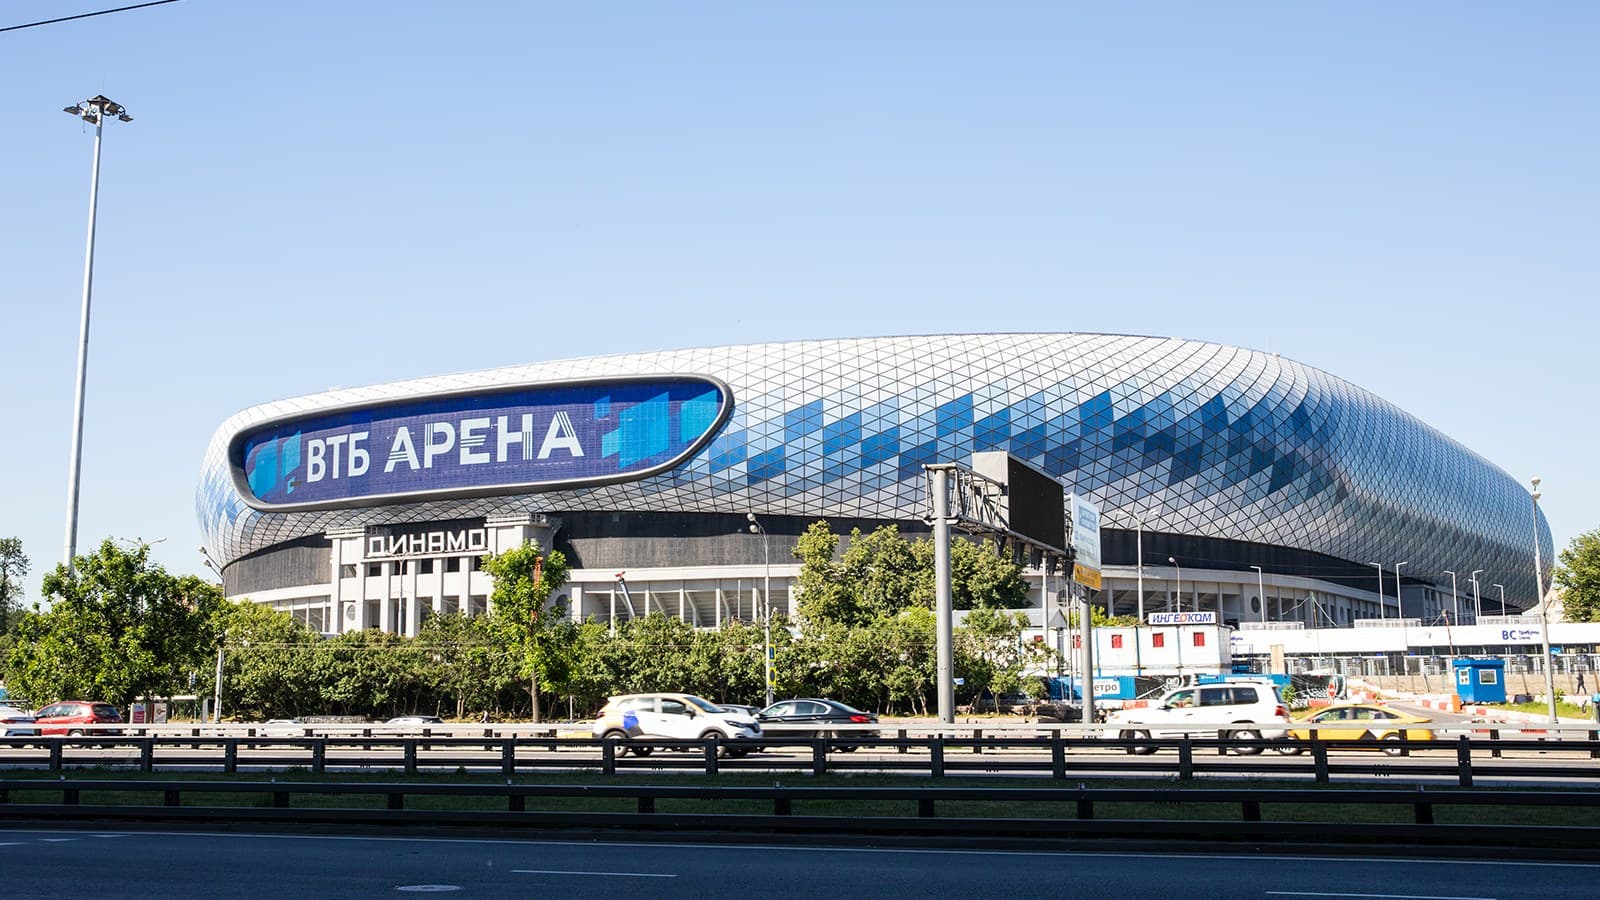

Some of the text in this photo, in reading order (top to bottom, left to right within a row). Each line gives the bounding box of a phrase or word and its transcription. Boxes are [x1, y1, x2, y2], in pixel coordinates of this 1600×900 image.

[307, 410, 585, 483] ВТБ АРЕНА
[367, 529, 486, 557] ДИНАМО
[1152, 613, 1212, 624] ИНГЕОКОМ
[1094, 684, 1118, 693] етро
